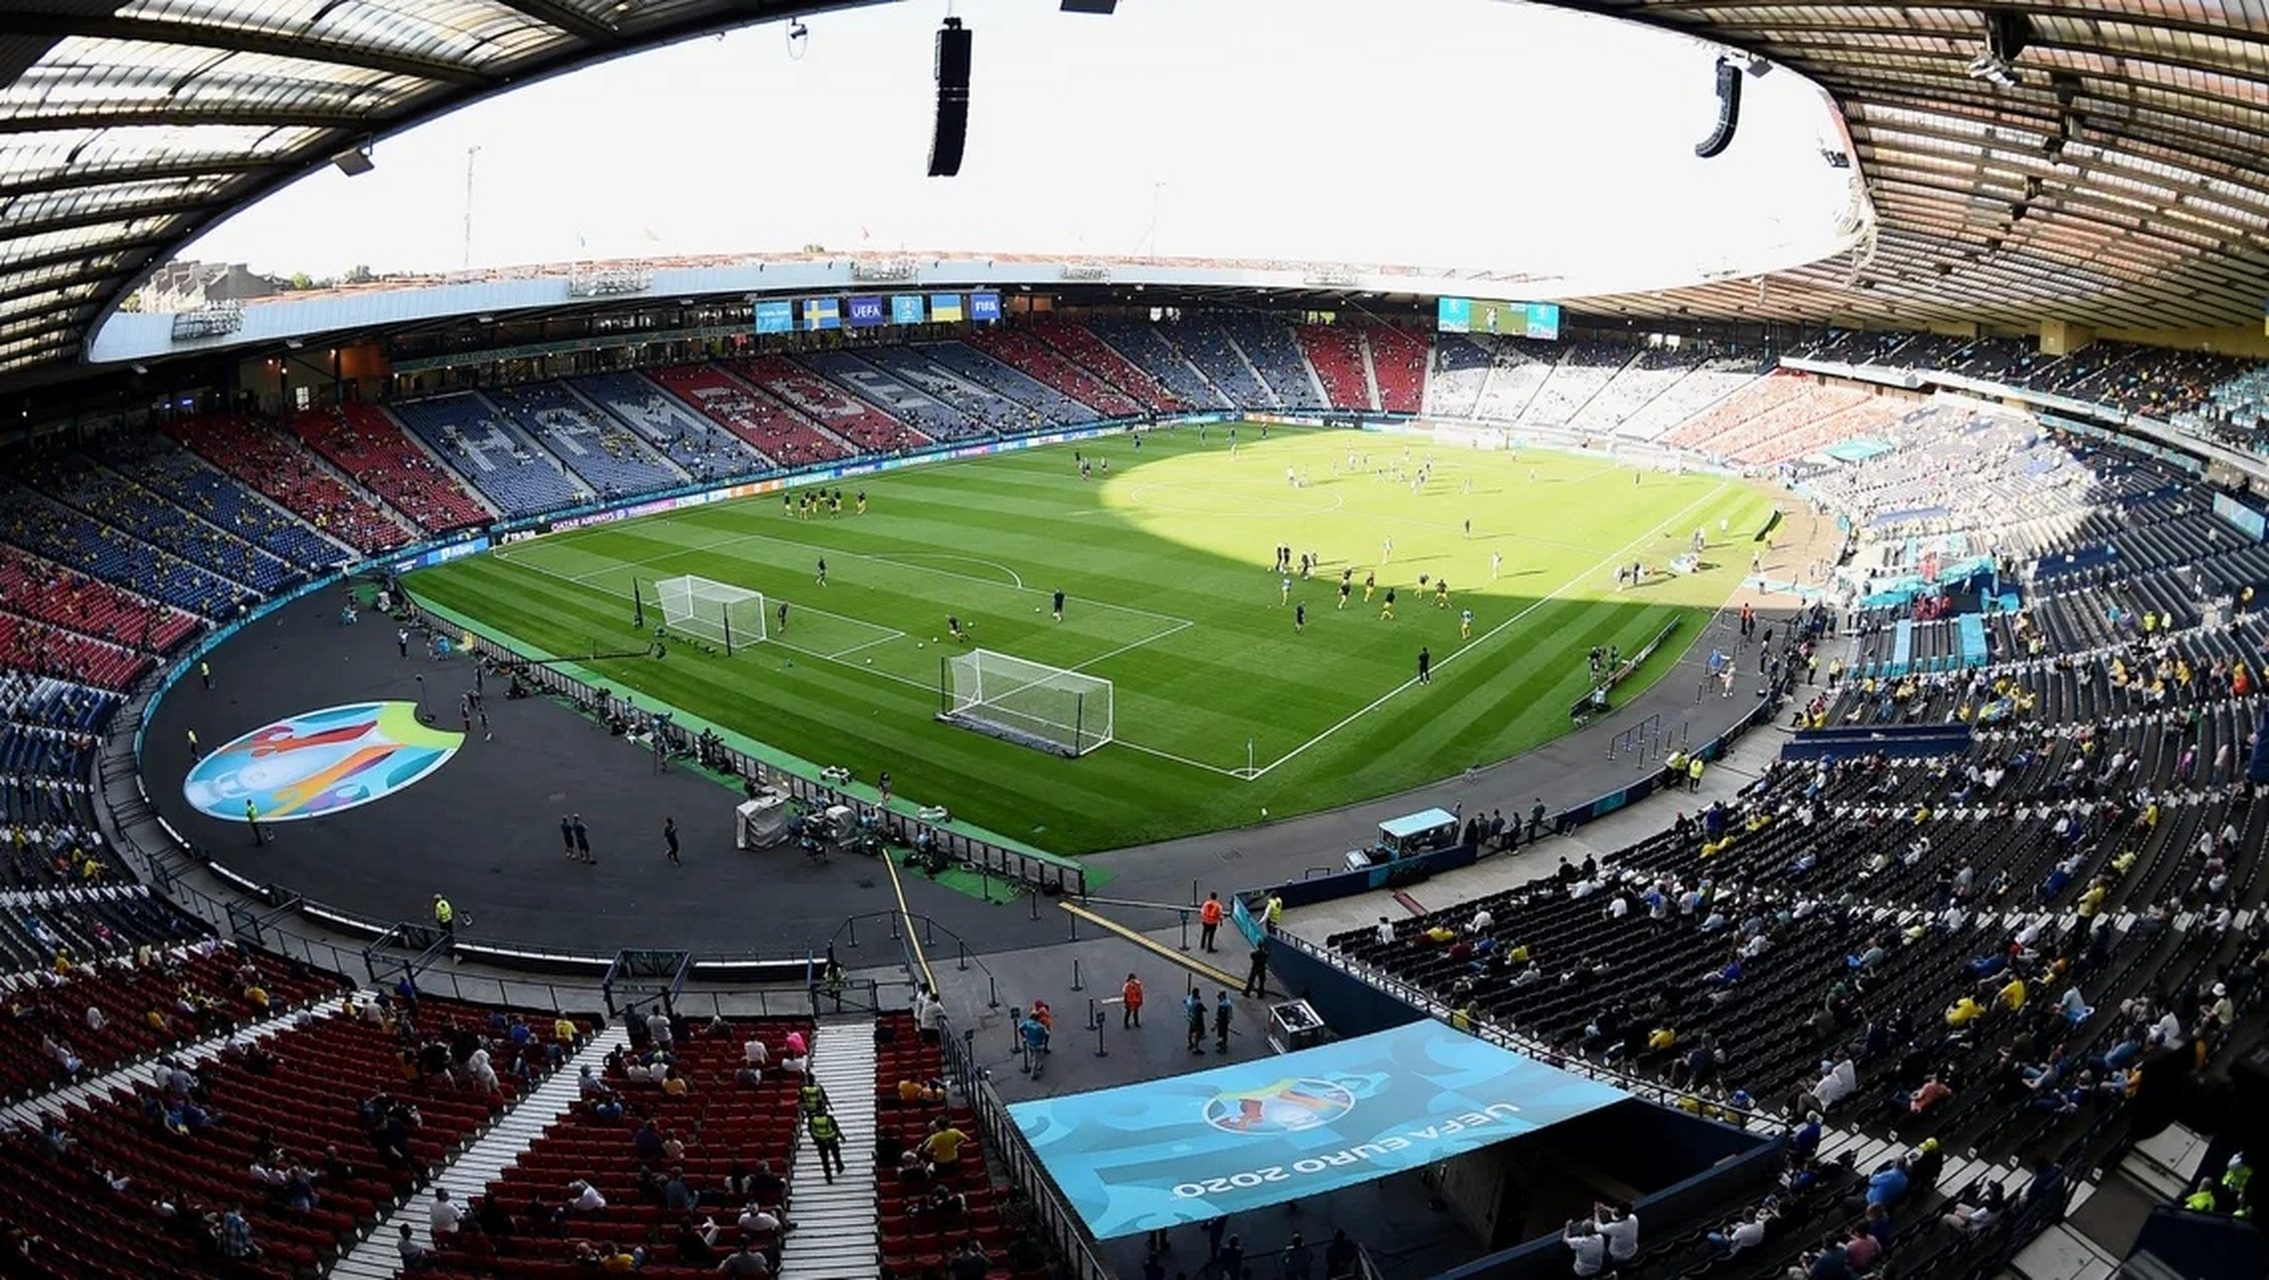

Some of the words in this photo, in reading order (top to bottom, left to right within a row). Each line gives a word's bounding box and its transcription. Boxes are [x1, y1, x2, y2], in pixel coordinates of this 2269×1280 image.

[852, 304, 881, 318] UEFA
[974, 301, 997, 312] FIFA
[551, 518, 580, 531] QATAR
[581, 512, 615, 526] AIRWAYS
[1408, 1102, 1522, 1141] UEFA
[1296, 1137, 1411, 1175] EURO
[1172, 1165, 1290, 1199] 2020
